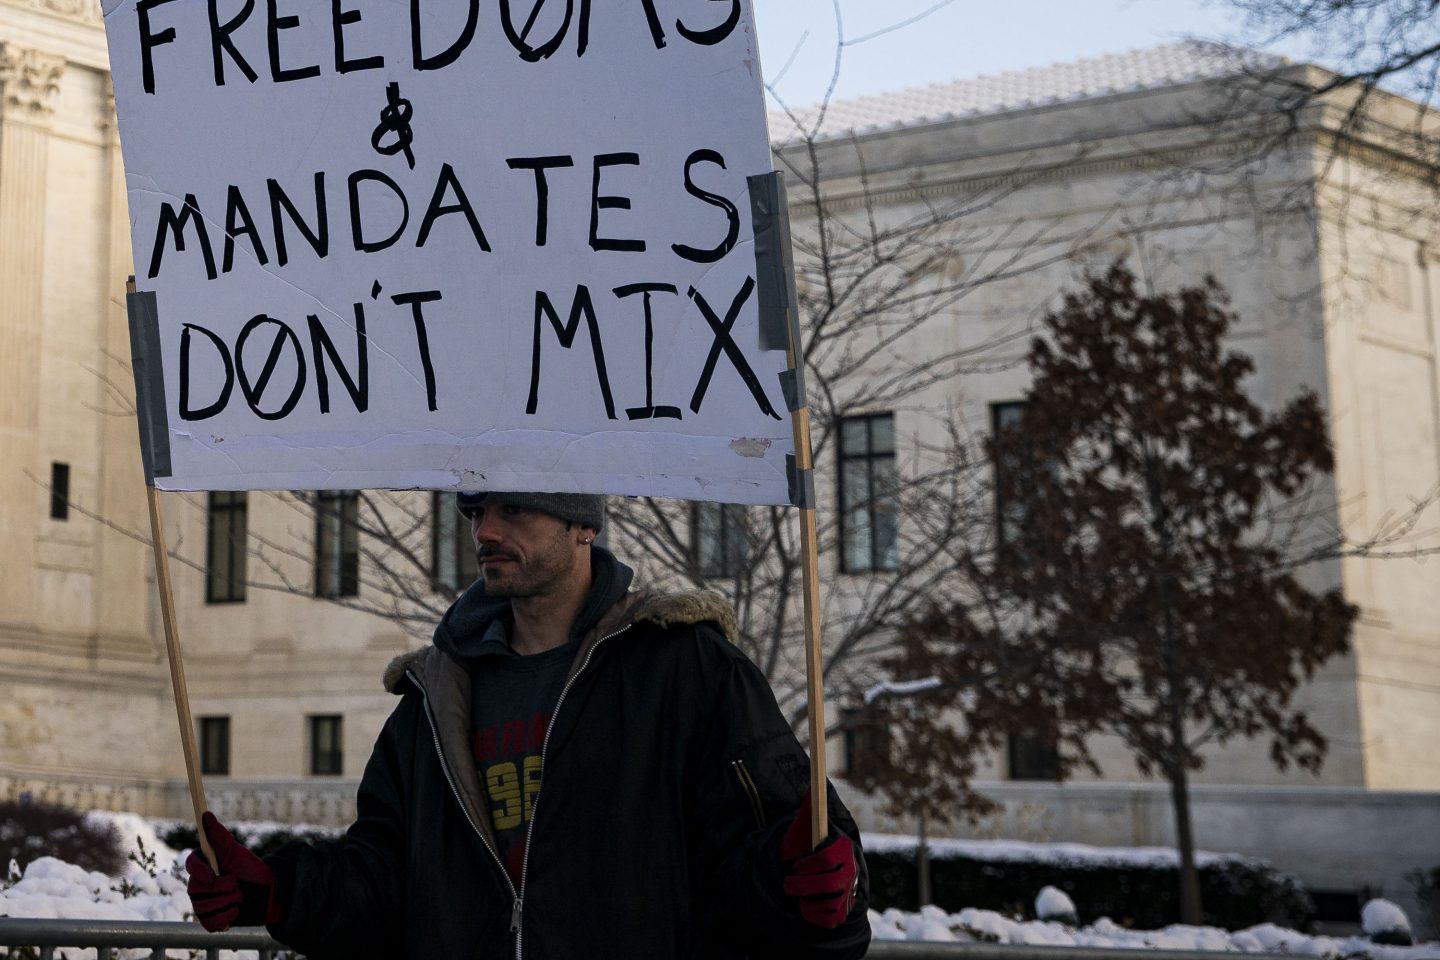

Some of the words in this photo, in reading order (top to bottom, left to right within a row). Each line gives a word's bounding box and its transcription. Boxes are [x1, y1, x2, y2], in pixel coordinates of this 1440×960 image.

[371, 82, 415, 170] &
[148, 149, 741, 280] MANDATES
[526, 275, 782, 421] MIX
